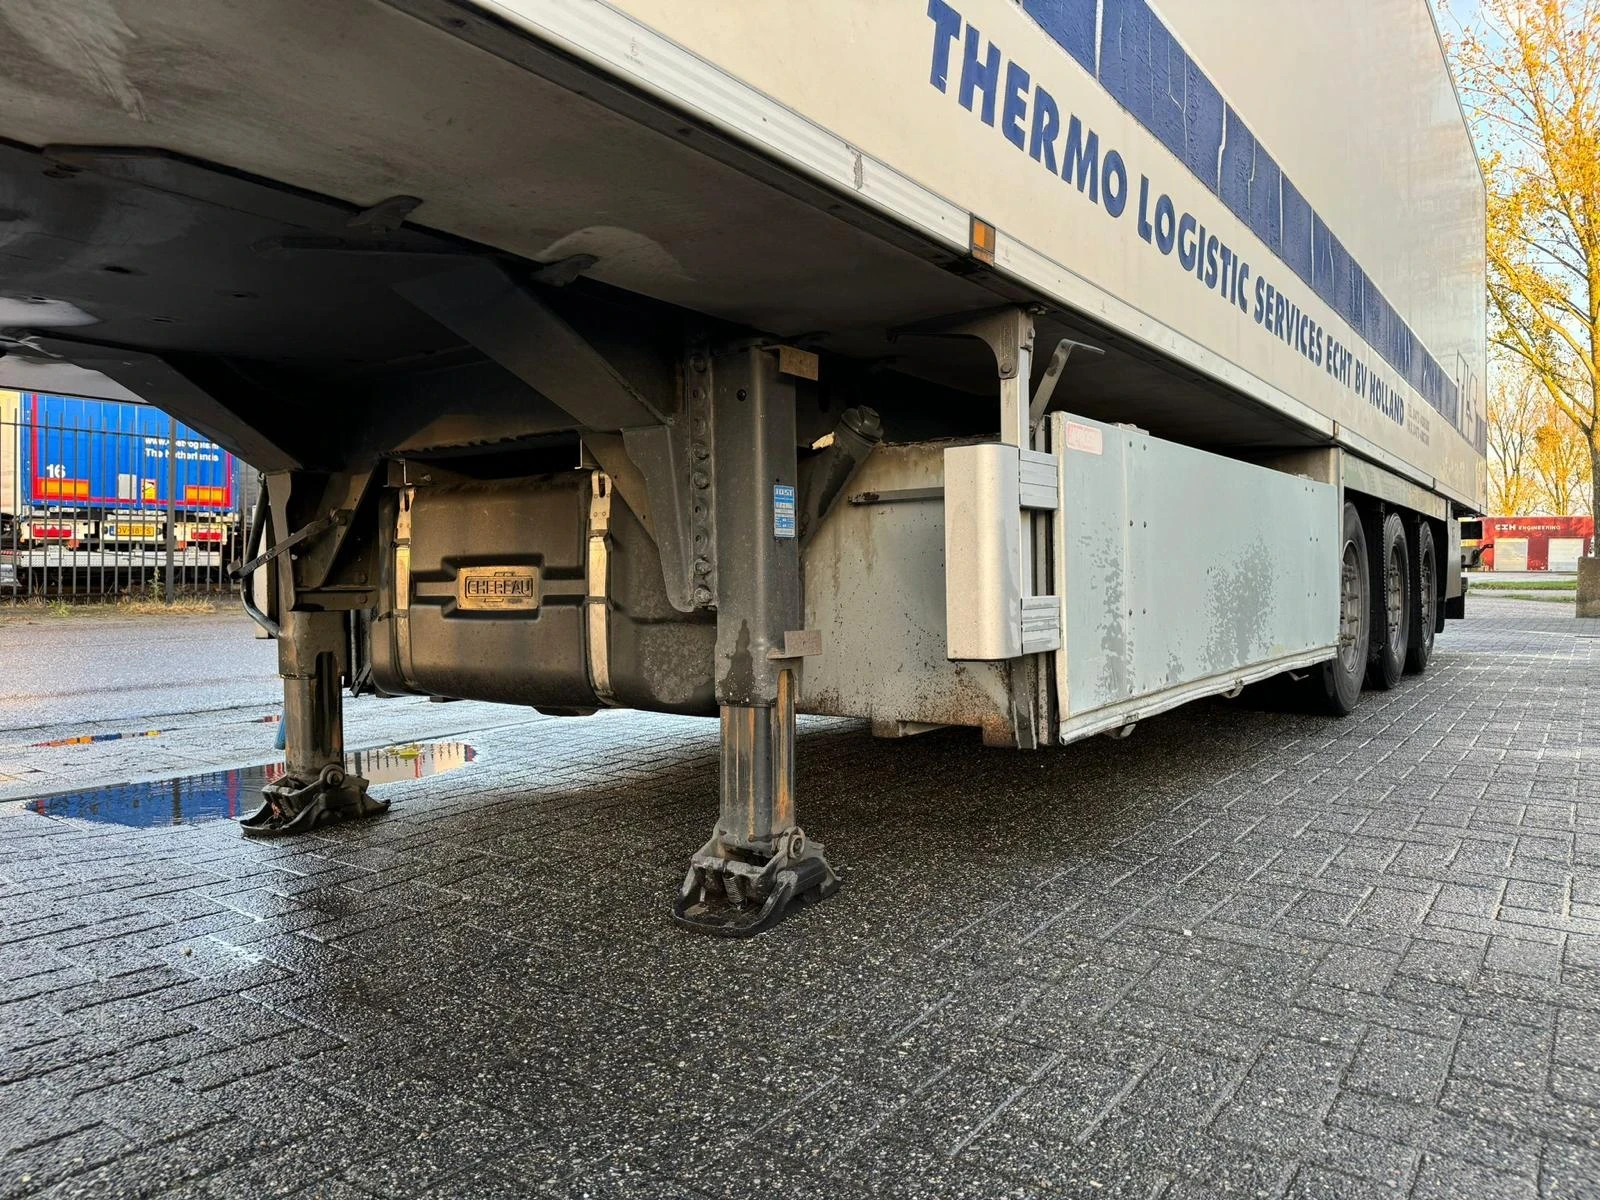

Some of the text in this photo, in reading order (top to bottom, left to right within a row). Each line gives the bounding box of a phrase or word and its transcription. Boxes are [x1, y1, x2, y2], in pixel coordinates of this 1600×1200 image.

[927, 0, 1128, 219] THERMO
[1137, 172, 1250, 314] LOGISTIC
[1254, 275, 1323, 367] SERVICES
[1326, 332, 1353, 389] ECHT
[1355, 357, 1368, 401] BV
[1369, 371, 1406, 427] HOLLAND
[145, 447, 164, 458] The
[46, 463, 66, 479] 16
[467, 579, 530, 595] CHEREAU
